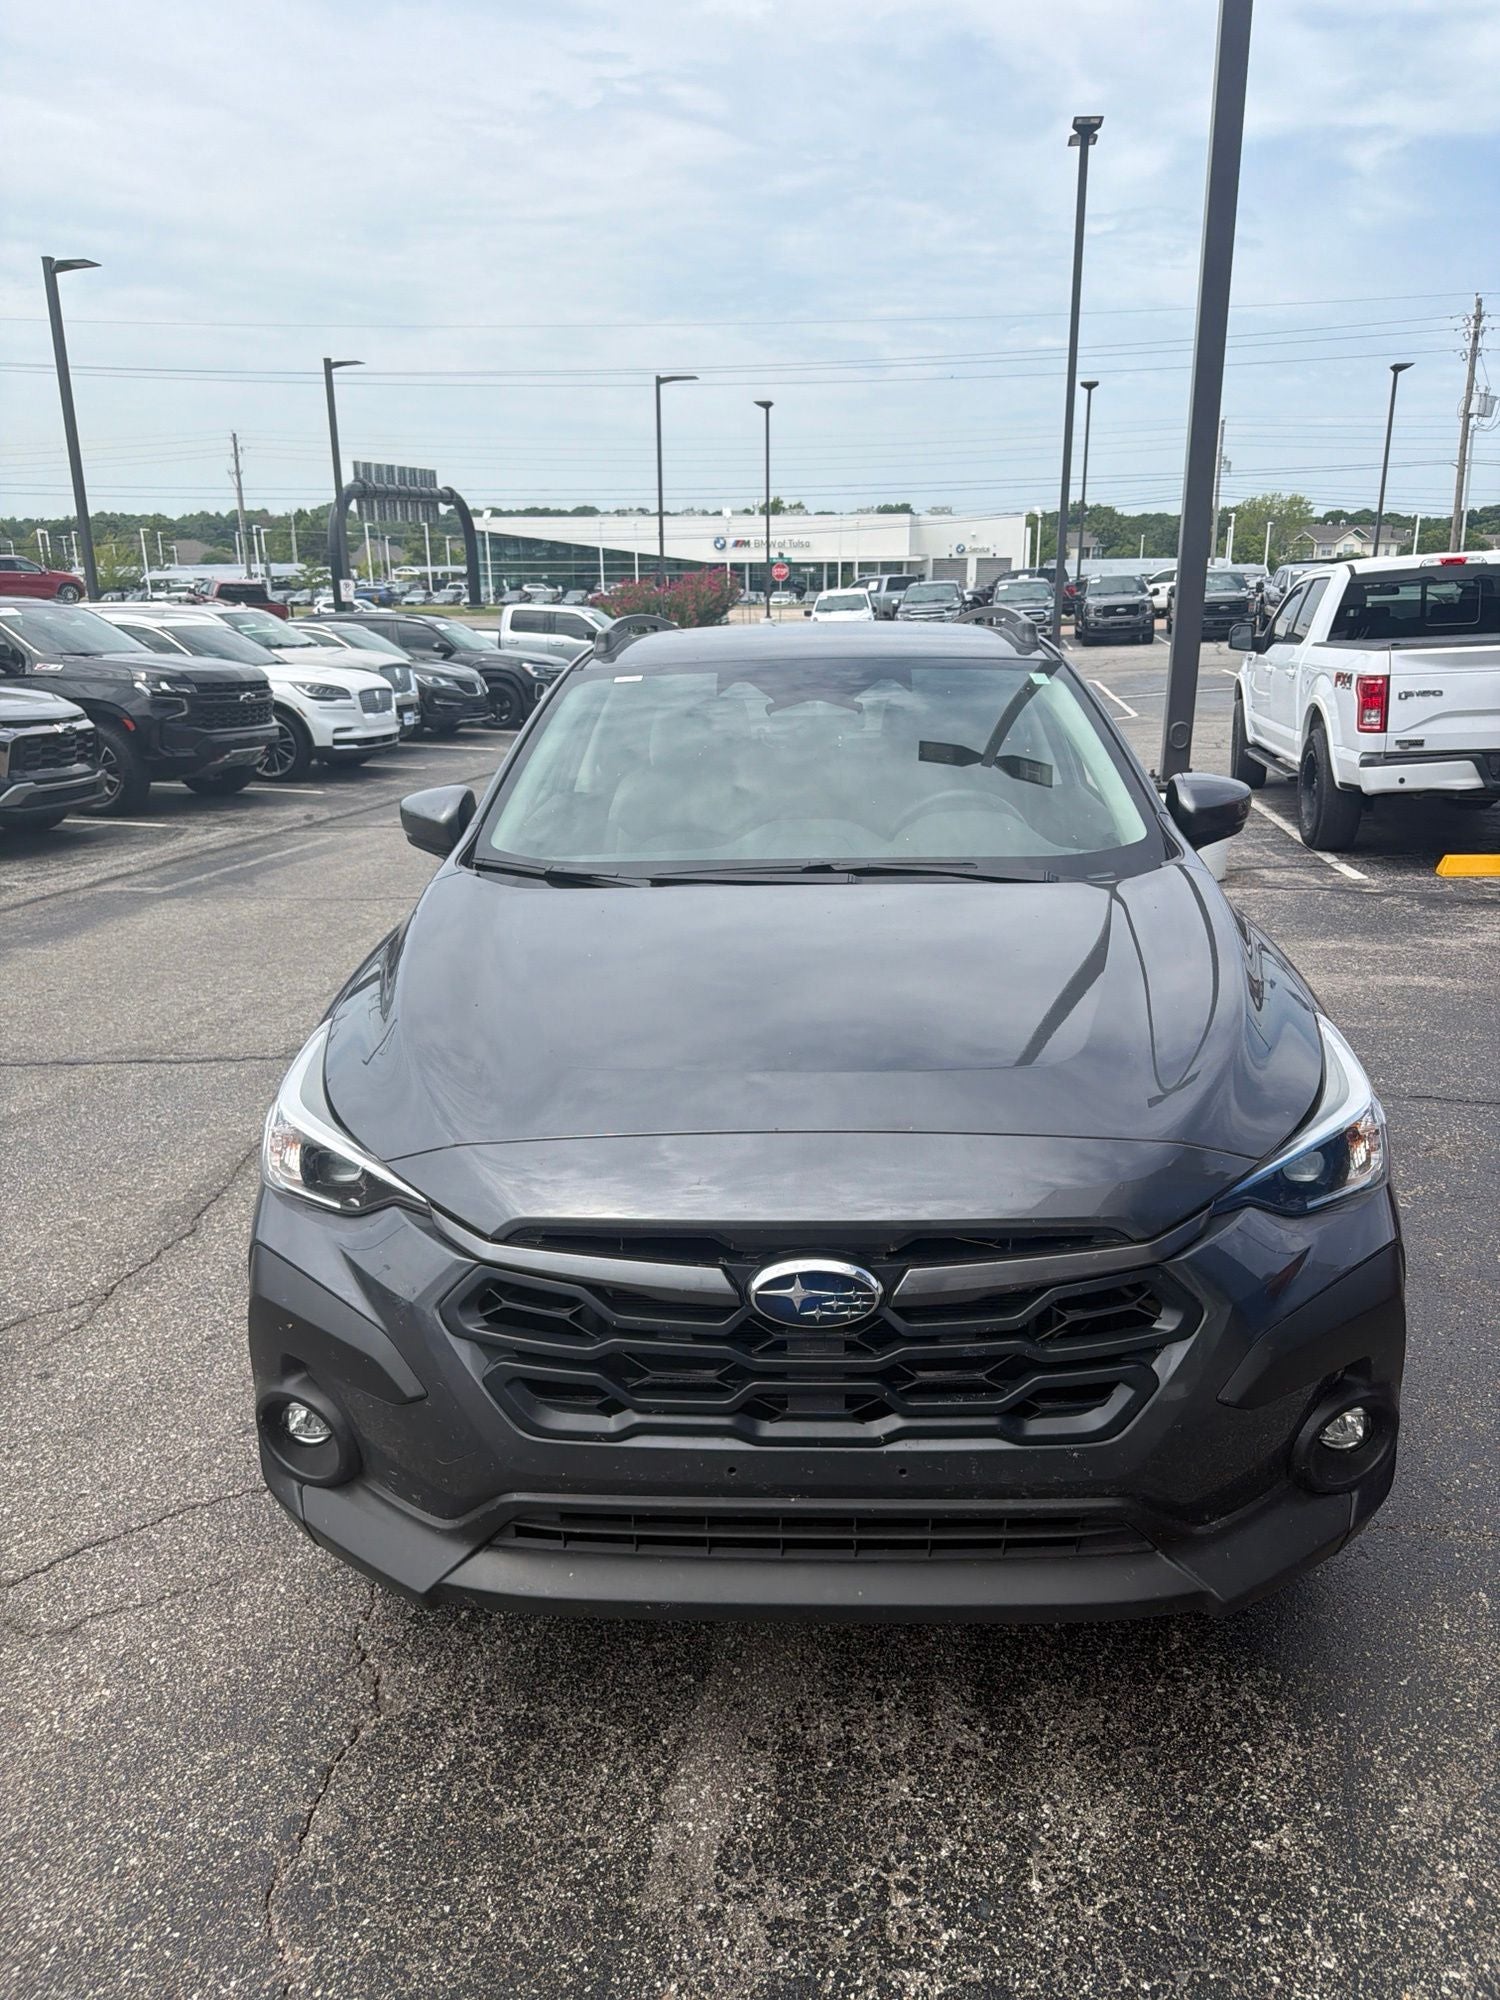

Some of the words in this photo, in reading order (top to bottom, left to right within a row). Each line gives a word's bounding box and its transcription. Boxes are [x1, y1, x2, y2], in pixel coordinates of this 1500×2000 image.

[754, 540, 777, 548] BMW
[778, 540, 787, 548] of
[788, 540, 811, 548] Tulsa
[1334, 672, 1353, 688] FX4
